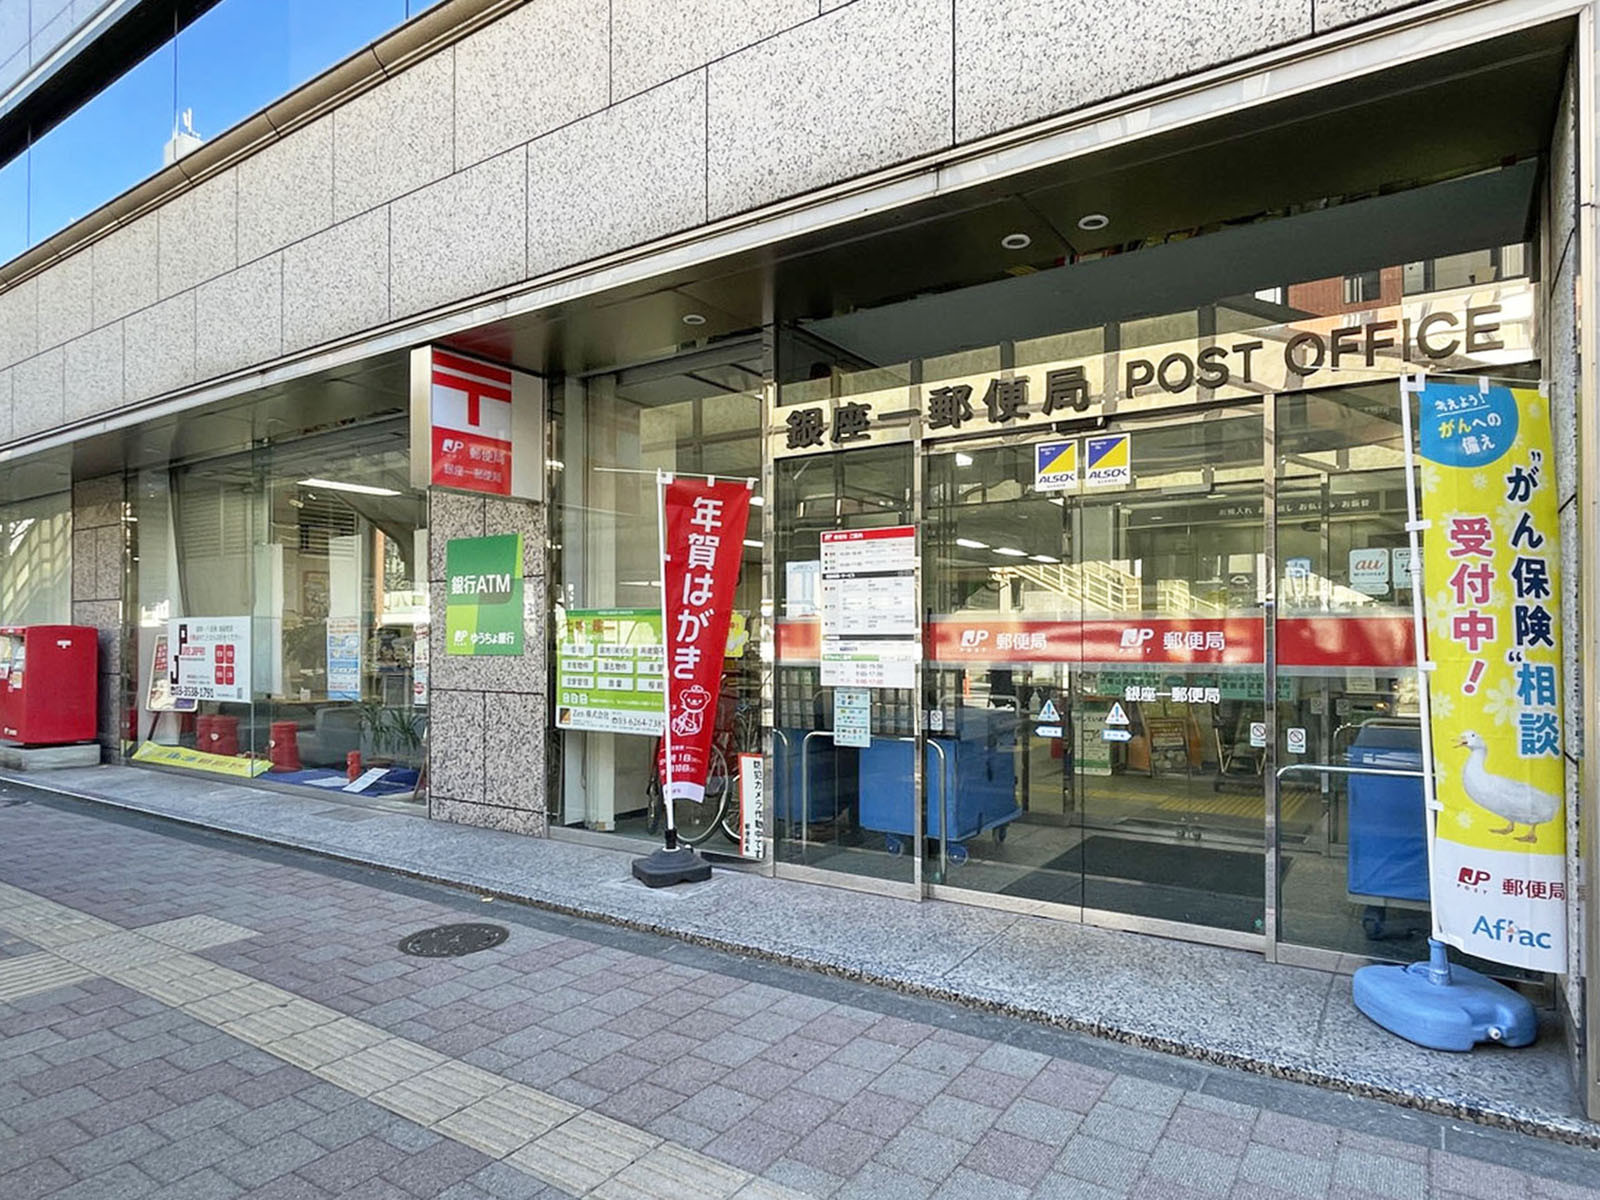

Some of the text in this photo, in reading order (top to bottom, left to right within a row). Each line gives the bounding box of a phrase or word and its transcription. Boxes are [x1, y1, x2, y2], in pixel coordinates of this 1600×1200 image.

[1125, 304, 1504, 399] POST OFFICE
[786, 365, 1090, 449] 銀座一郵便局
[1438, 412, 1502, 438] がんへの
[1039, 473, 1075, 483] ALSOK
[1088, 468, 1127, 479] ALSOK
[1355, 559, 1385, 571] au
[451, 573, 511, 595] 銀行ATM
[673, 496, 724, 680] 年賀はがき
[470, 631, 515, 645] ゆうちょ銀行
[996, 631, 1048, 650] 郵便局
[1163, 631, 1226, 652] 郵便局
[1124, 685, 1222, 705] 銀座一郵便局
[1502, 878, 1566, 900] 郵便局
[1471, 915, 1552, 949] Aflac
